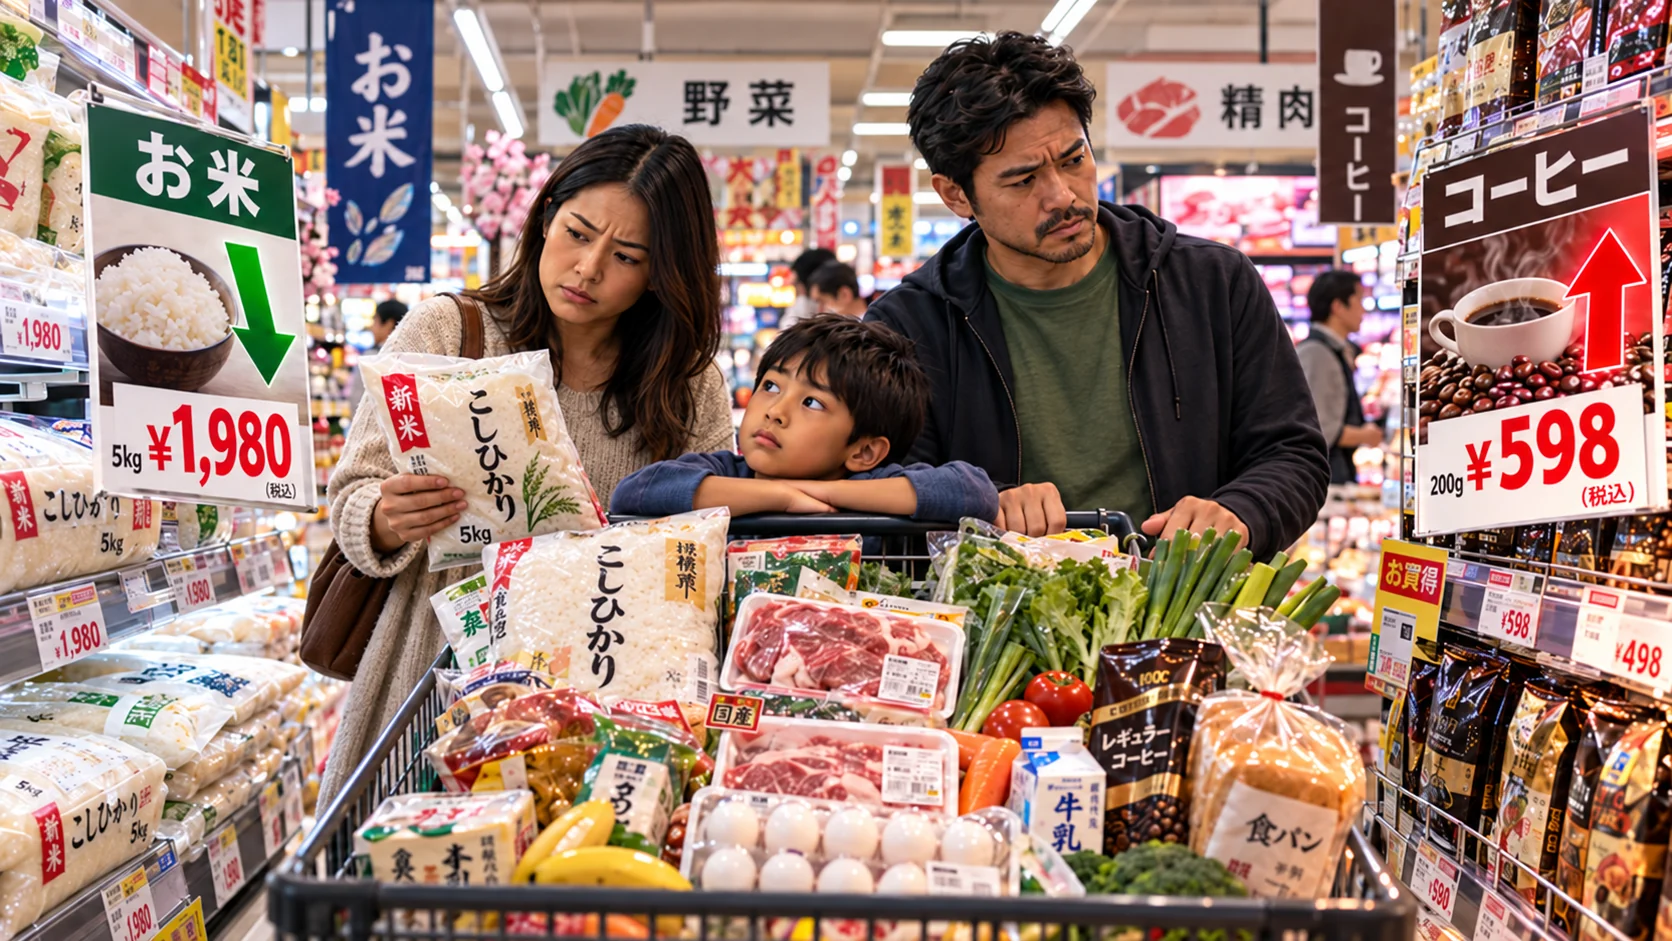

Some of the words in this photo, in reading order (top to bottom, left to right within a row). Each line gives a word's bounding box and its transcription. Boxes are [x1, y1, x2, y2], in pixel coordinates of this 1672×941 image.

[344, 32, 416, 178] お米
[682, 79, 796, 127] 野菜
[1220, 83, 1313, 129] 精肉
[135, 131, 261, 218] お米
[1345, 106, 1370, 222] コーヒー
[1444, 147, 1629, 229] コーヒー
[17, 317, 61, 352] ¥1,980
[388, 384, 424, 441] 新米
[112, 444, 142, 474] 5kg
[146, 404, 291, 487] ¥1,980
[468, 389, 516, 523] こしひかり
[1430, 473, 1463, 497] 200g
[1465, 402, 1620, 490] ¥598
[10, 480, 33, 532] 新米
[266, 481, 296, 499] (税込)
[1581, 481, 1634, 508] (税込)
[100, 532, 124, 556] 5kg
[460, 525, 492, 545] 5kg
[1385, 558, 1439, 596] お買得
[586, 544, 625, 689] こしひかり
[1501, 609, 1531, 639] ¥598
[55, 620, 101, 660] ¥1,980
[1615, 639, 1663, 678] ¥498
[713, 704, 753, 727] 国産
[1102, 724, 1171, 751] レギュラー
[1111, 748, 1168, 770] コーヒー
[15, 780, 43, 798] 5kg
[71, 792, 138, 849] こしひかり
[130, 819, 148, 844] 5kg
[1051, 791, 1083, 852] 牛乳
[1245, 812, 1324, 854] 食パン
[44, 814, 62, 872] 新米
